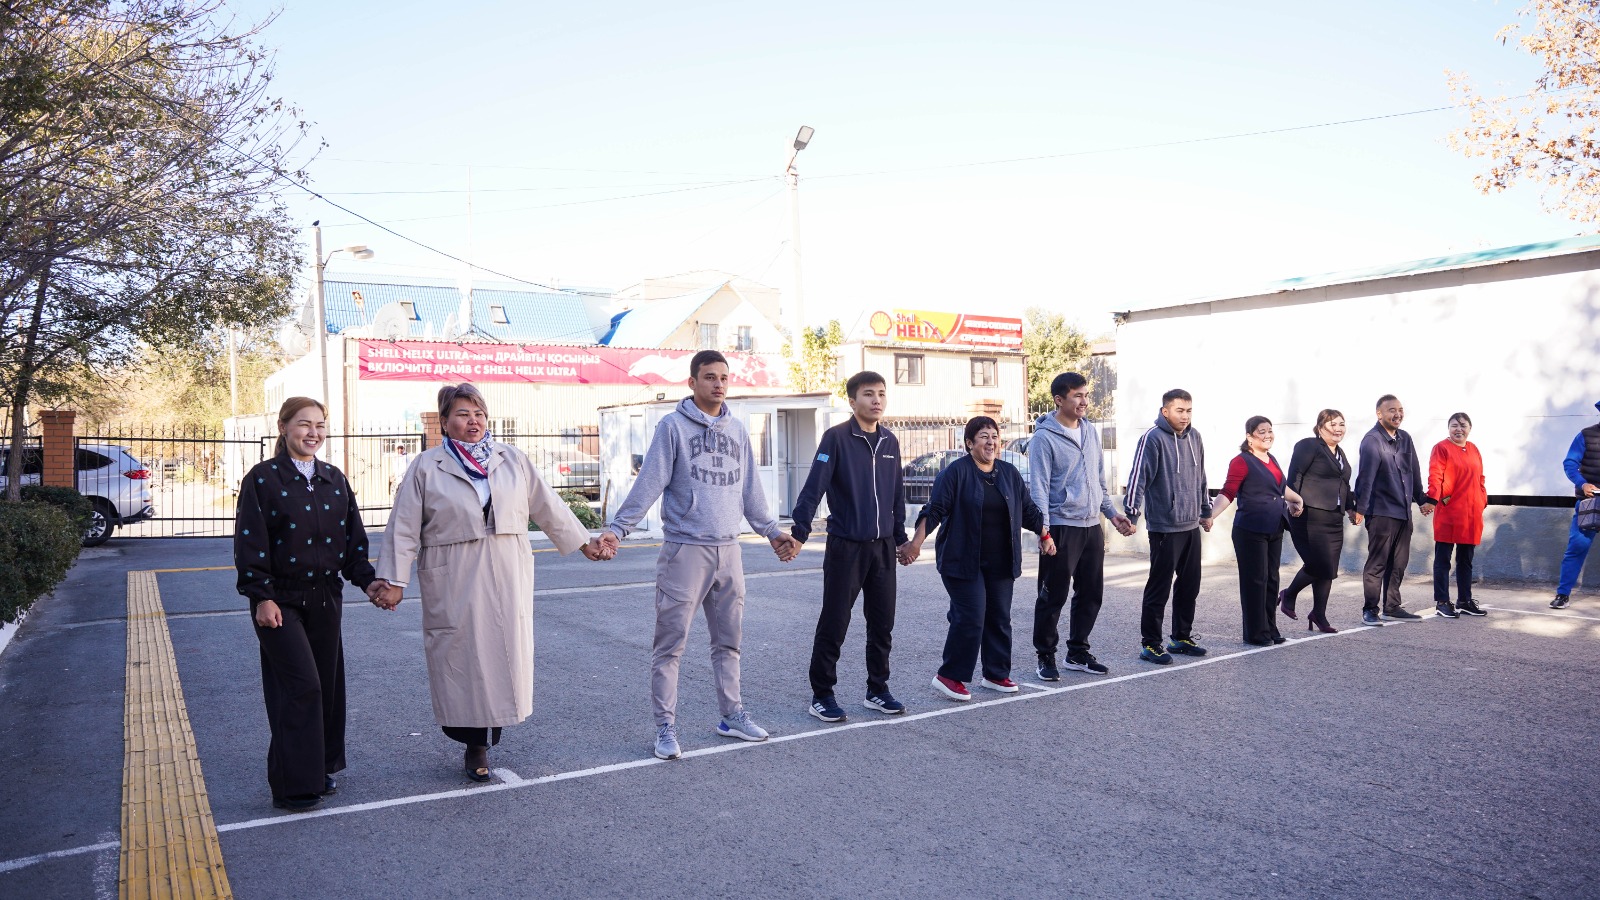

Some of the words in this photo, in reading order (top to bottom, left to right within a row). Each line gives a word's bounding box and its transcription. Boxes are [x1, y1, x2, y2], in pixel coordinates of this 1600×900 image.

[896, 313, 916, 323] Shell
[896, 322, 942, 339] HELIX
[367, 348, 401, 358] SHELL
[402, 349, 435, 360] HELIX
[495, 350, 546, 363] ДРАЙВТЫ
[367, 362, 432, 373] ВКЛЮЧИТЕ
[433, 361, 472, 375] ДРАЙВ
[483, 366, 513, 375] SHELL
[515, 366, 545, 376] HELIX
[546, 367, 577, 377] ULTRA
[688, 432, 741, 466] BORN
[711, 456, 723, 468] IN
[690, 464, 741, 487] ATYRAU
